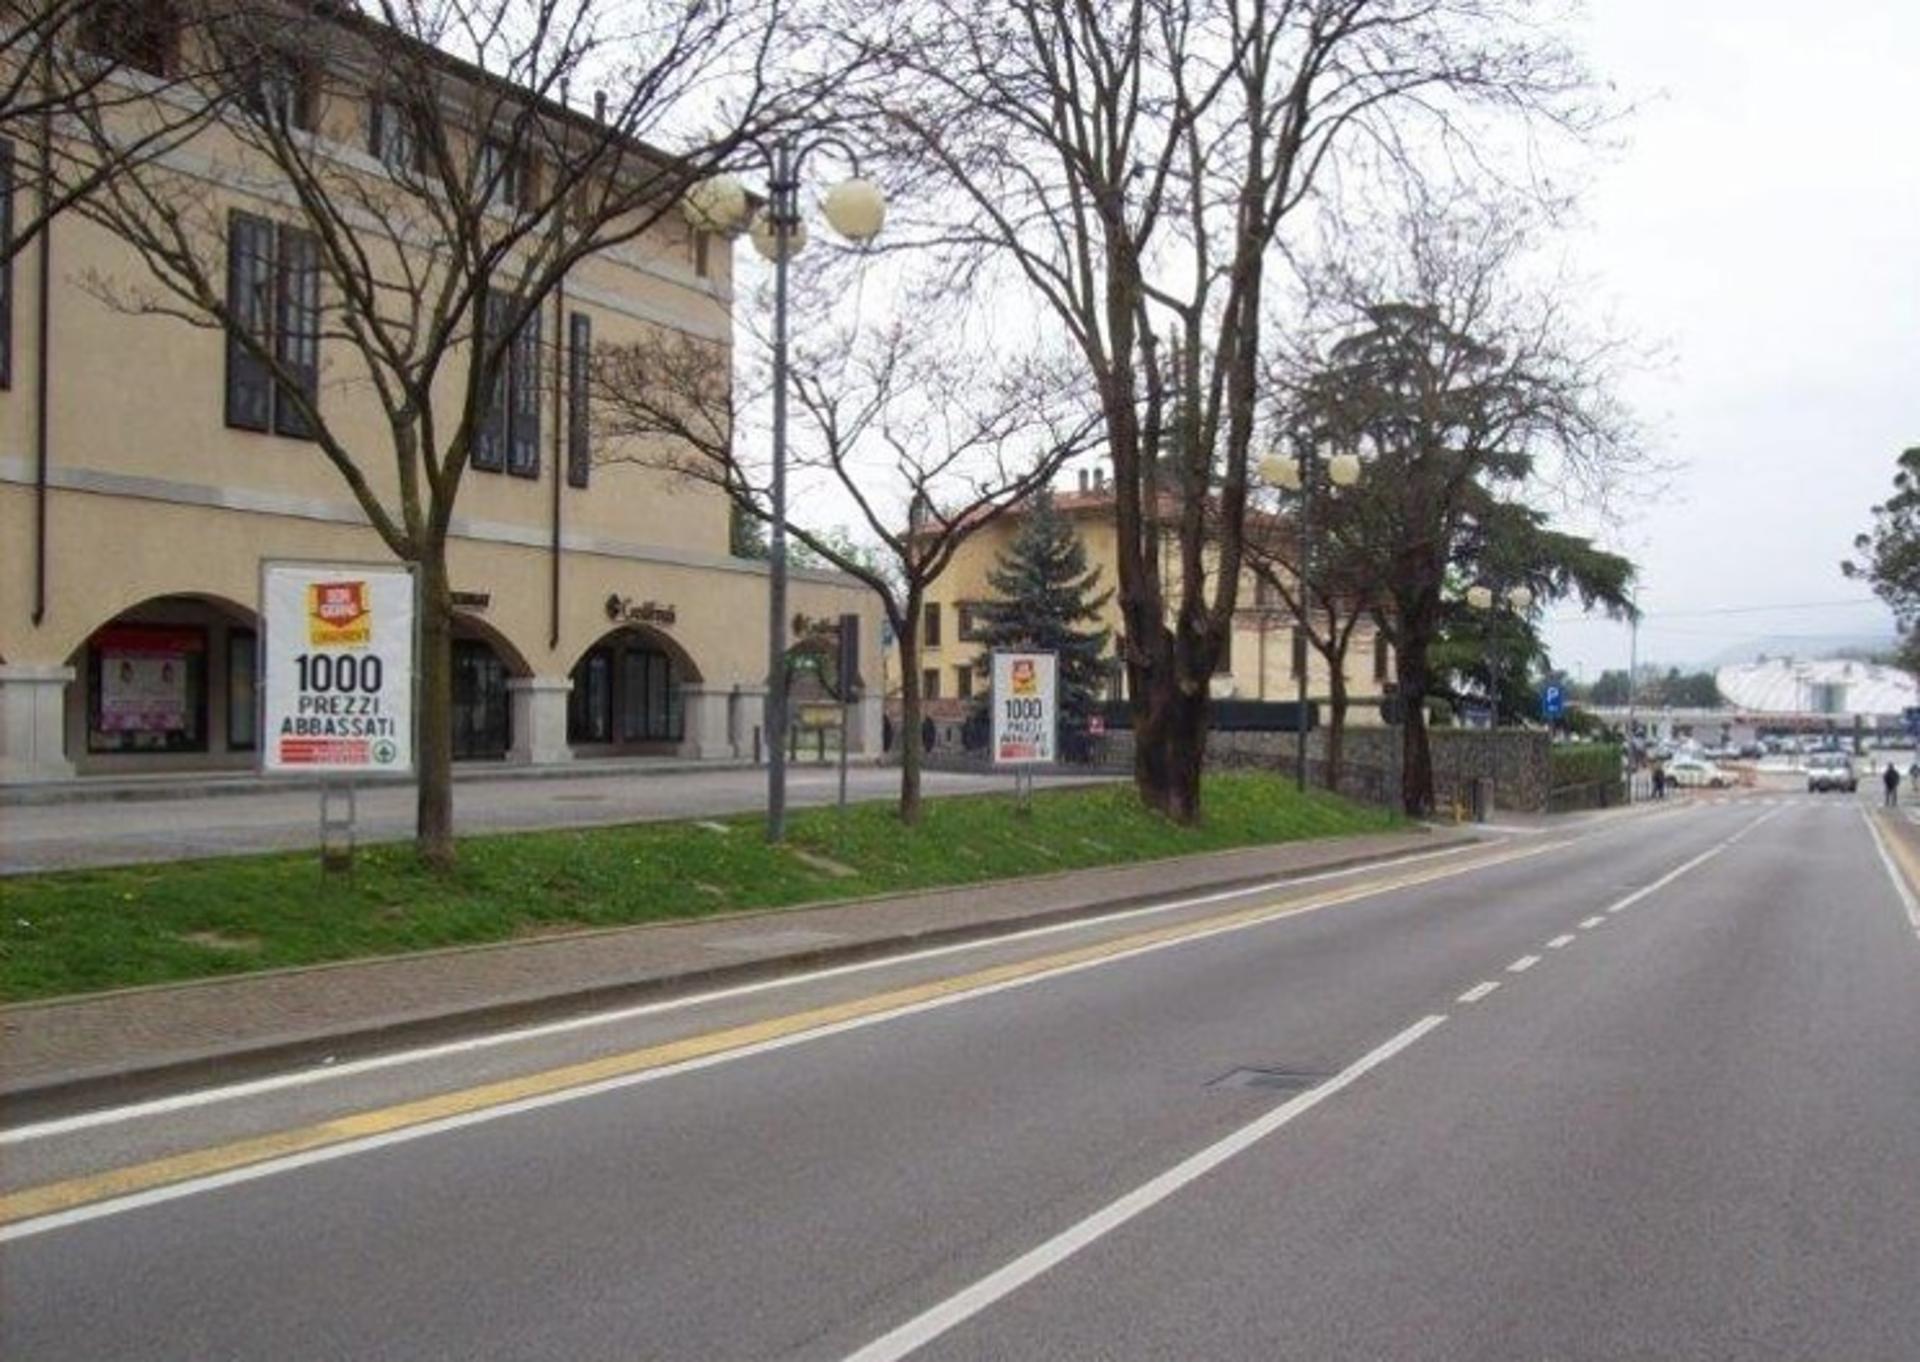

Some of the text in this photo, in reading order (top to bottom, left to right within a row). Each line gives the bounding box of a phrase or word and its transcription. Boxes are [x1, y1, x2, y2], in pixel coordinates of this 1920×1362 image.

[295, 653, 382, 693] 1000
[1547, 686, 1559, 702] P
[298, 696, 380, 715] PREZZI
[1005, 698, 1042, 719] 1000
[281, 716, 395, 737] ABBASSATI
